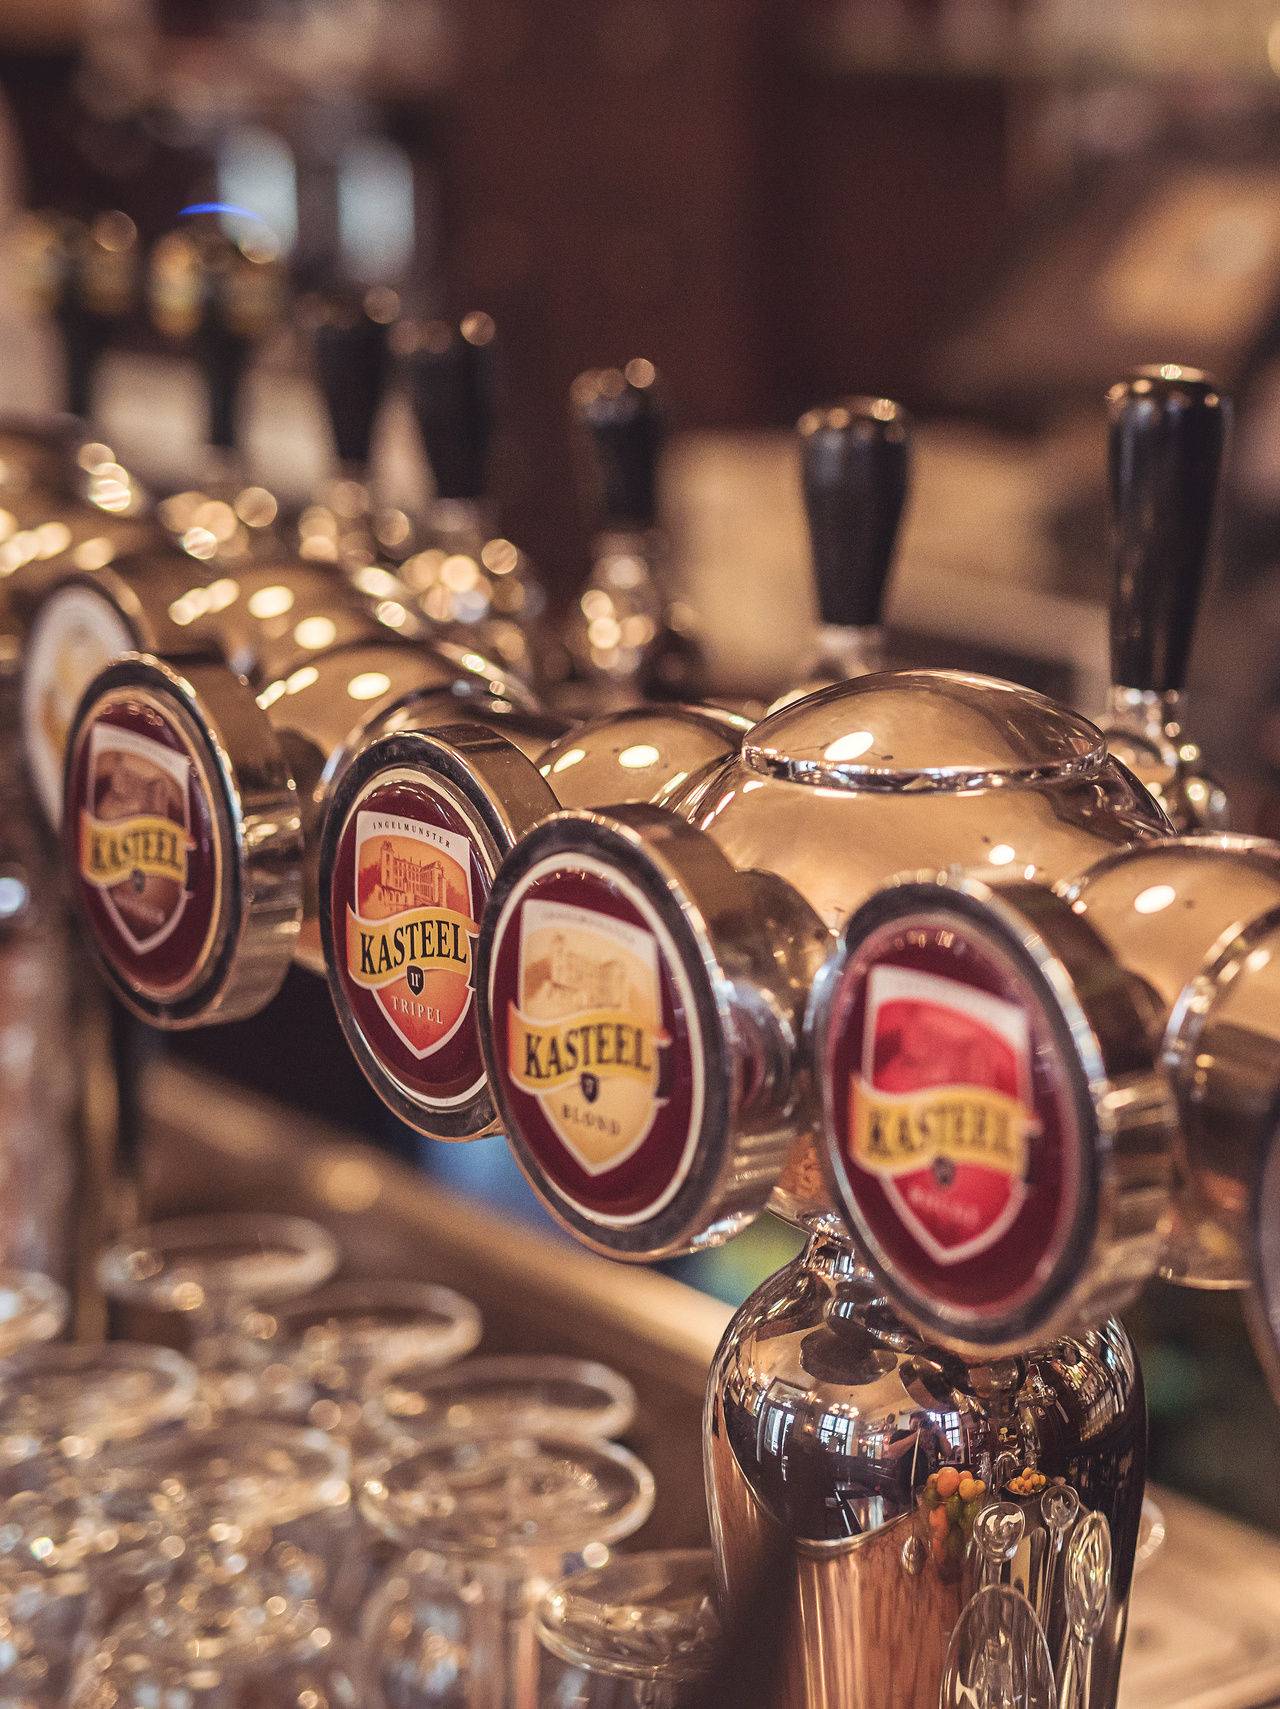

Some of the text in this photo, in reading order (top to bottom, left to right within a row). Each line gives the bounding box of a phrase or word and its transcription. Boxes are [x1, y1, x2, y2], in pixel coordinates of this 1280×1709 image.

[372, 821, 451, 849] INGELMUNSTER
[360, 920, 467, 975] KASTEEL
[391, 995, 444, 1025] TRIPEL
[524, 1023, 651, 1080] KASTEEL
